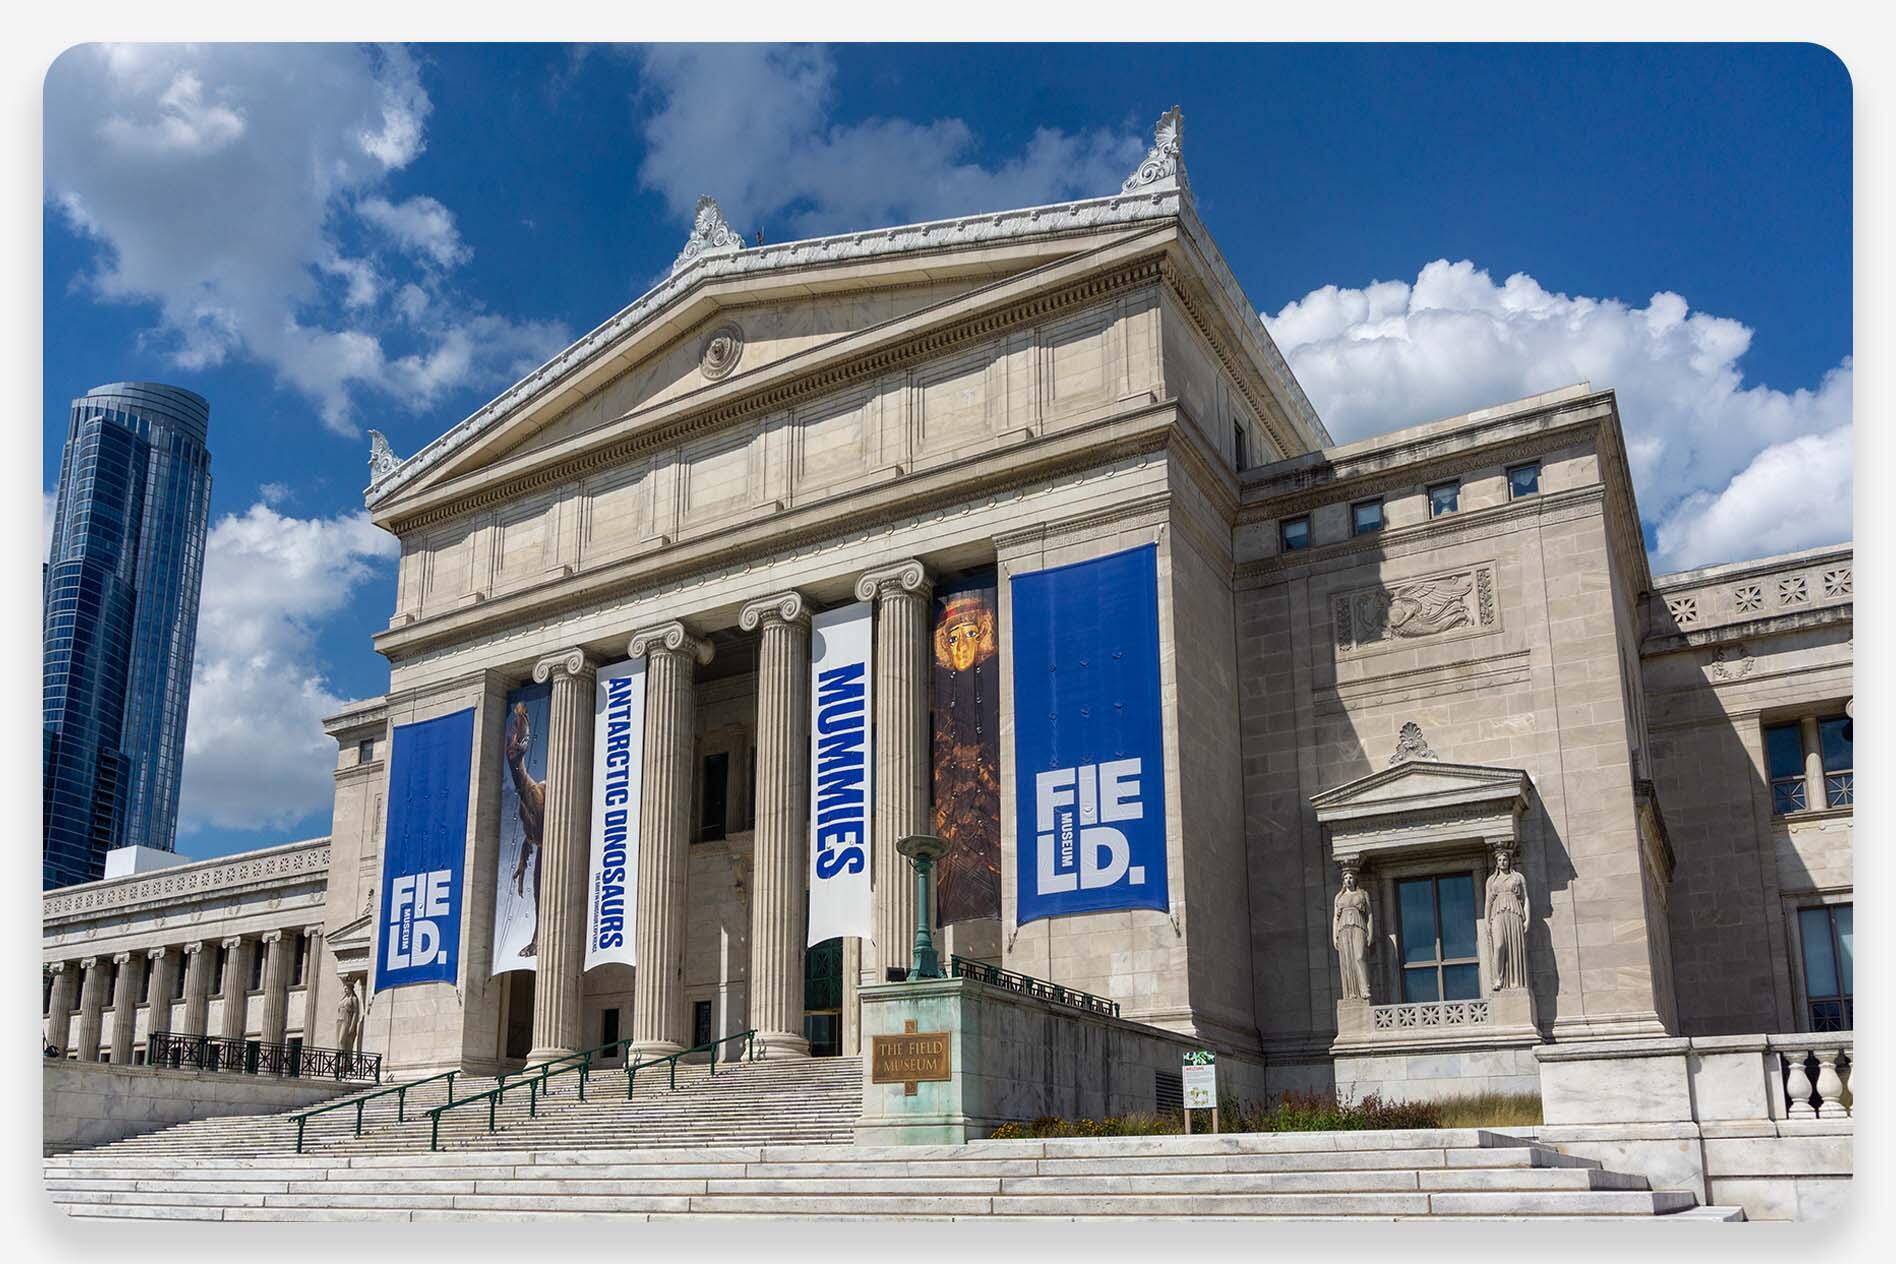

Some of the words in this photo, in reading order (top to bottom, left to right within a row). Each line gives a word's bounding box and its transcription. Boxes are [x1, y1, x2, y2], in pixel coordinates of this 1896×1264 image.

[605, 676, 633, 807] ANTARCTIC
[816, 661, 865, 880] MUMMIES
[1061, 811, 1073, 868] MUSEUM
[599, 809, 628, 949] DINOSAURS
[402, 907, 411, 950] MUSEUM
[880, 1042, 904, 1057] THE
[909, 1040, 944, 1056] FIELD
[883, 1058, 937, 1073] MUSEUM
